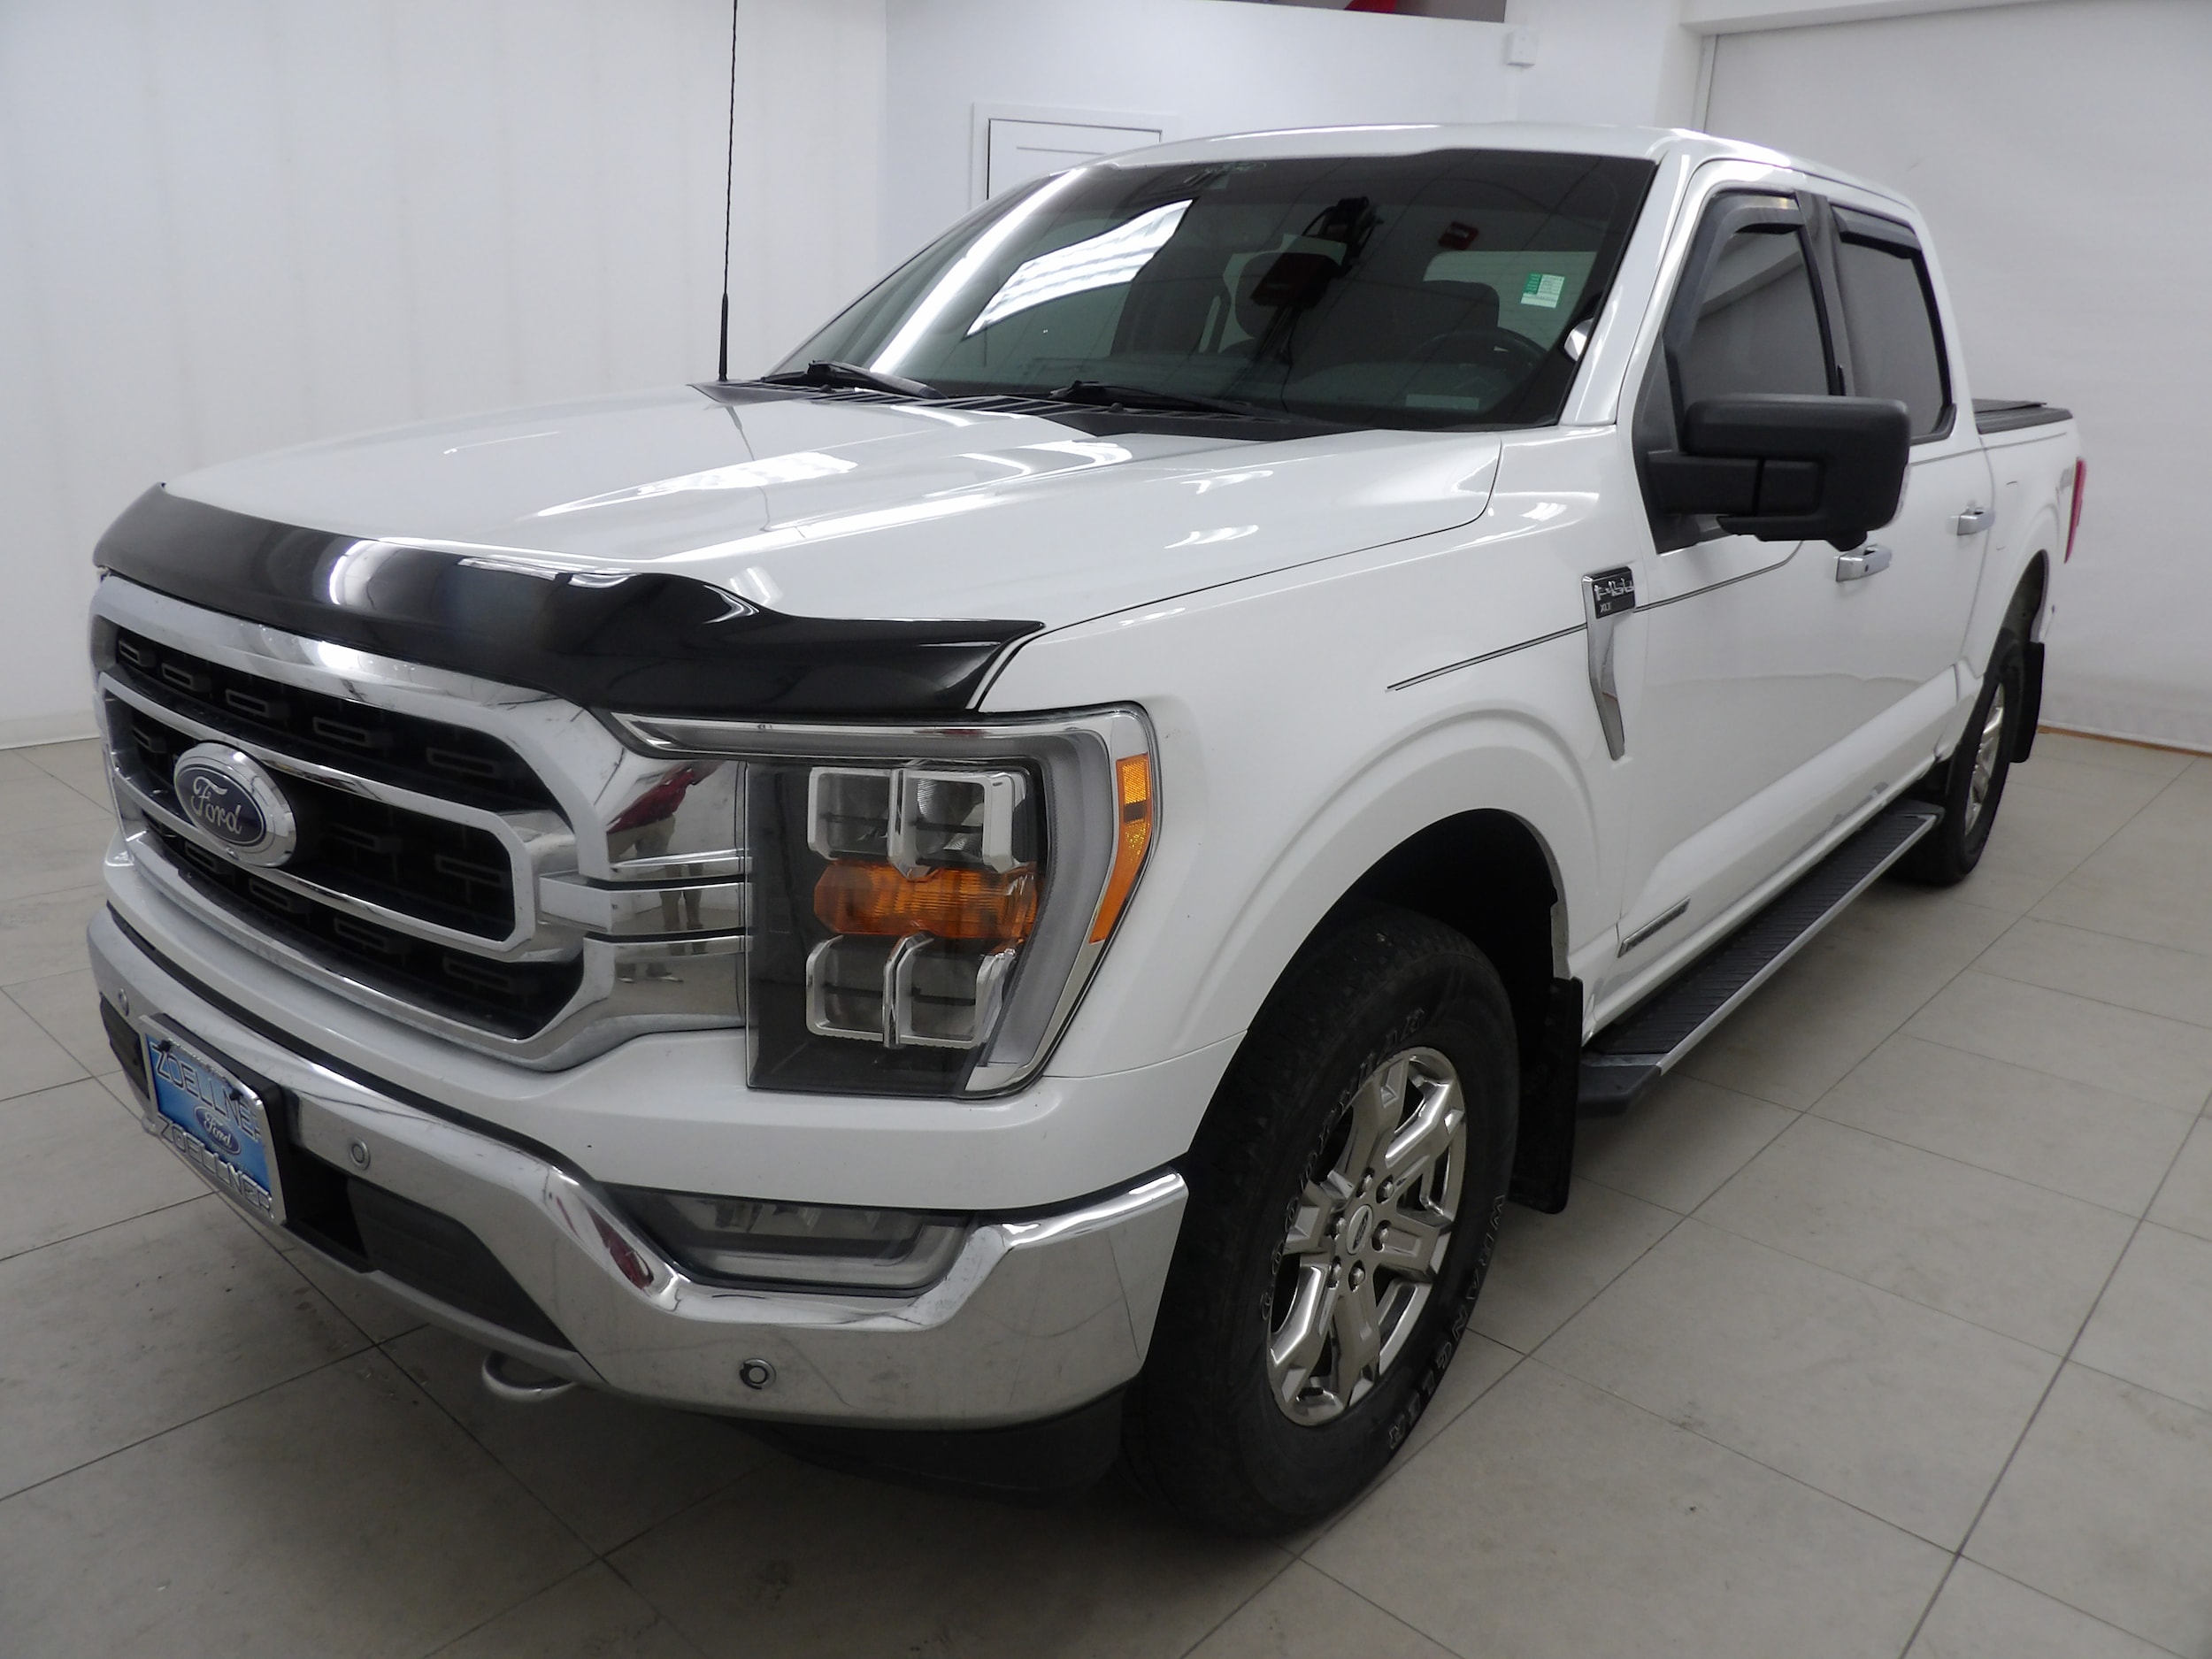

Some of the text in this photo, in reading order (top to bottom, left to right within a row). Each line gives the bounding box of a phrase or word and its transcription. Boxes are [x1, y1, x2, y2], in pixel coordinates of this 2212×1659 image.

[191, 775, 242, 834] Ford
[157, 1111, 275, 1220] ZOELLNER
[204, 1112, 232, 1148] Ford
[1386, 1194, 1506, 1451] WRANGLER
